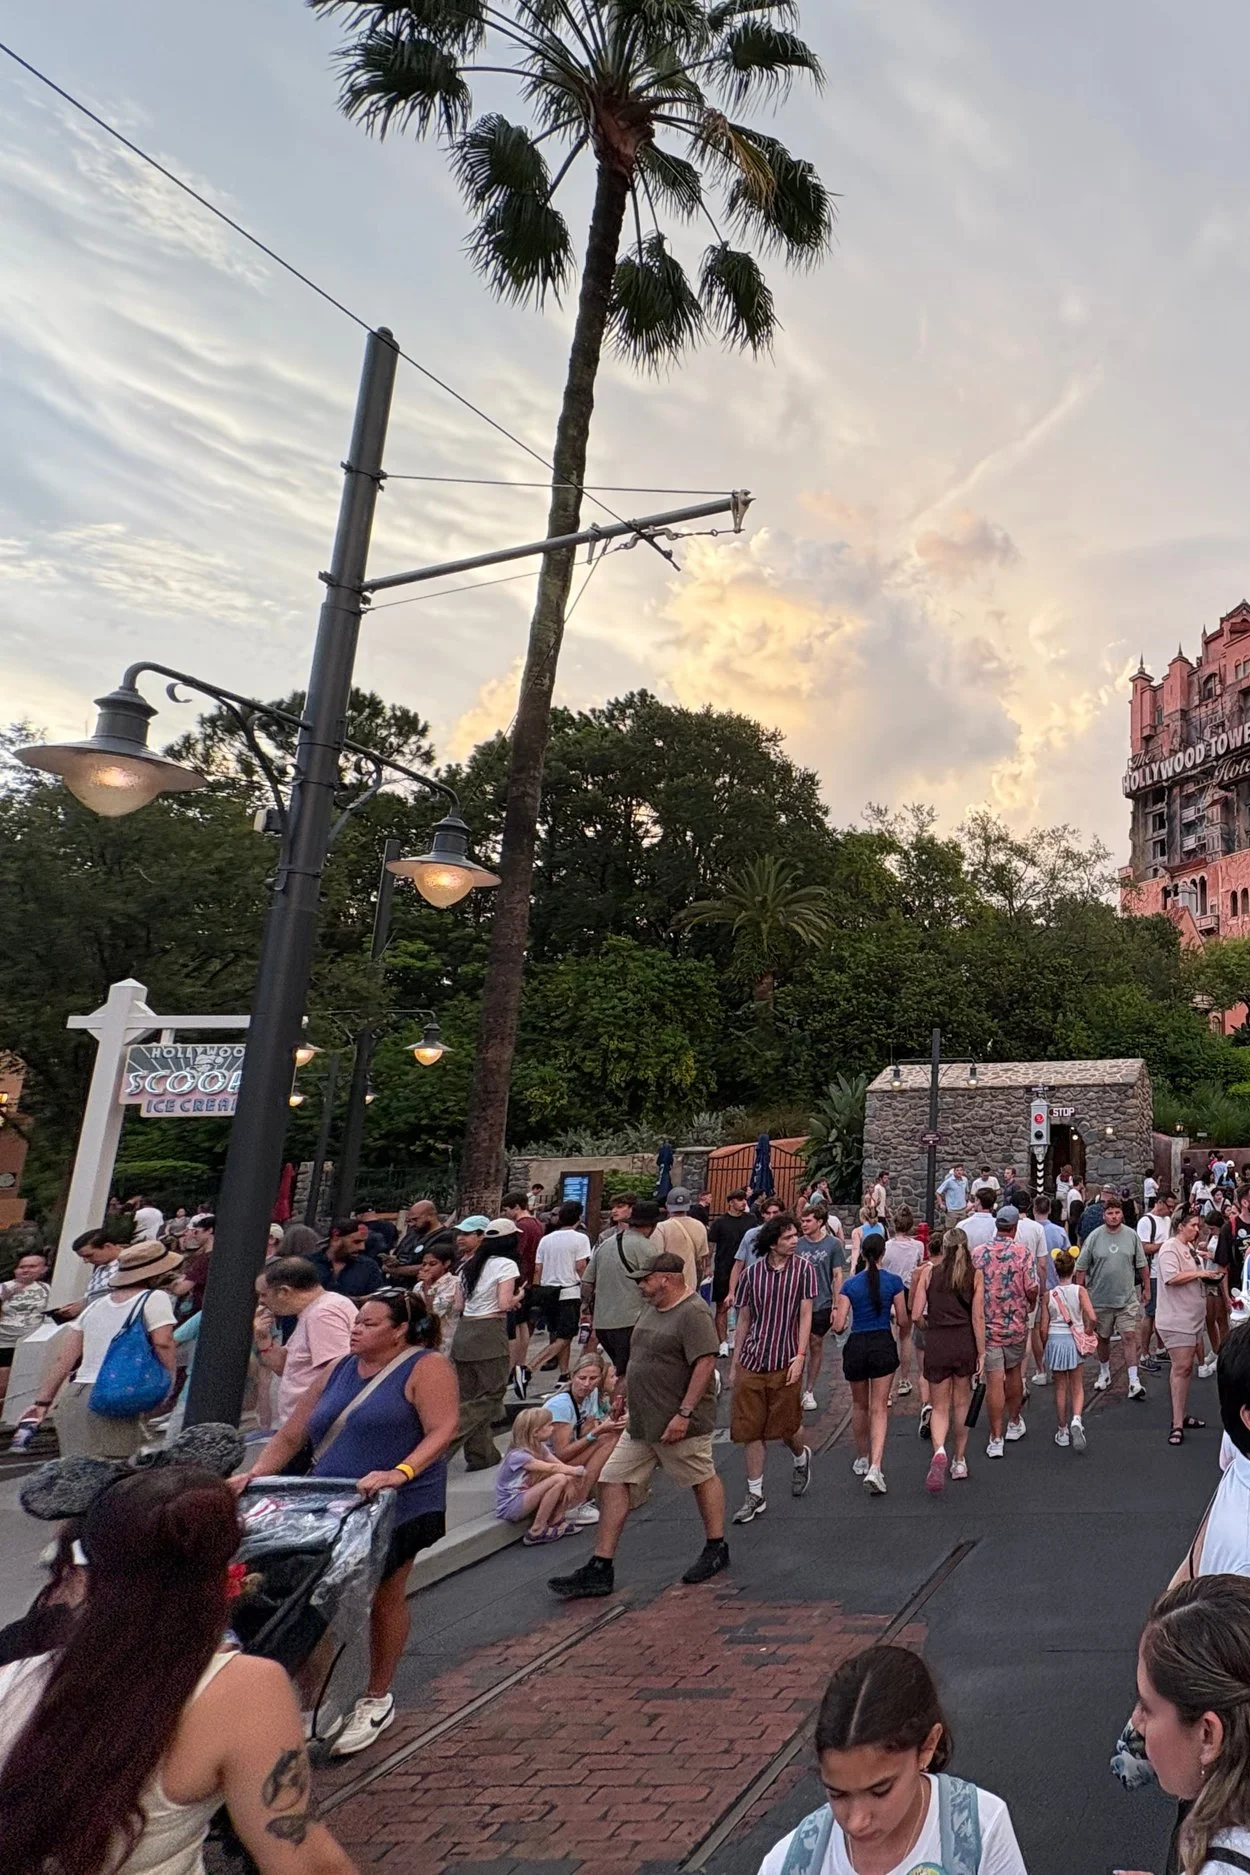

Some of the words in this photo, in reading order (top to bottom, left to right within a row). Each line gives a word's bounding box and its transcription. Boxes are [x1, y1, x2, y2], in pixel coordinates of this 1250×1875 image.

[1121, 743, 1206, 795] HOLLYWOOD
[146, 1098, 176, 1114] ICE
[180, 1098, 236, 1113] CREA
[1052, 1107, 1075, 1118] STOP
